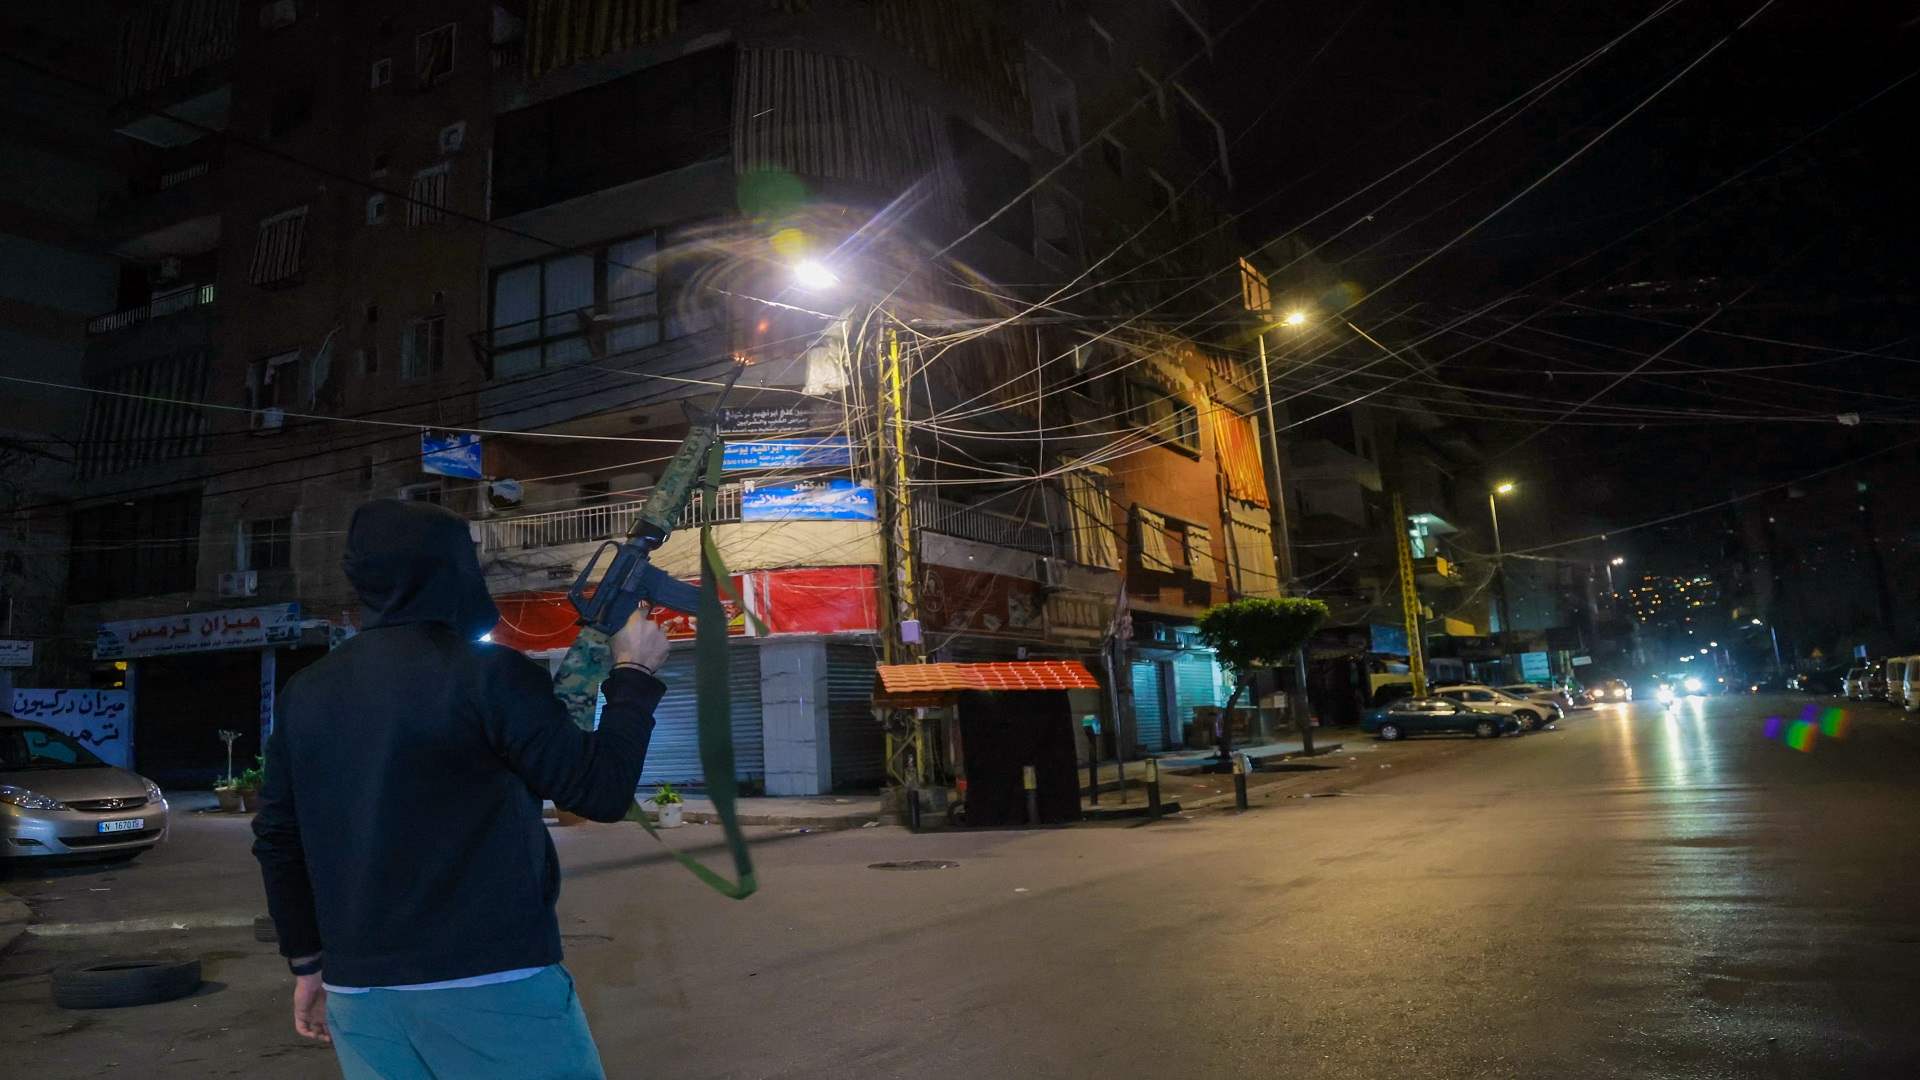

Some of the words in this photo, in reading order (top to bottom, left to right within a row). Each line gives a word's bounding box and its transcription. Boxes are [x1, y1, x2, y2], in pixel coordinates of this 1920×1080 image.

[201, 615, 261, 636] ميزان
[13, 689, 75, 716] دركسيون
[79, 691, 125, 718] ميزان
